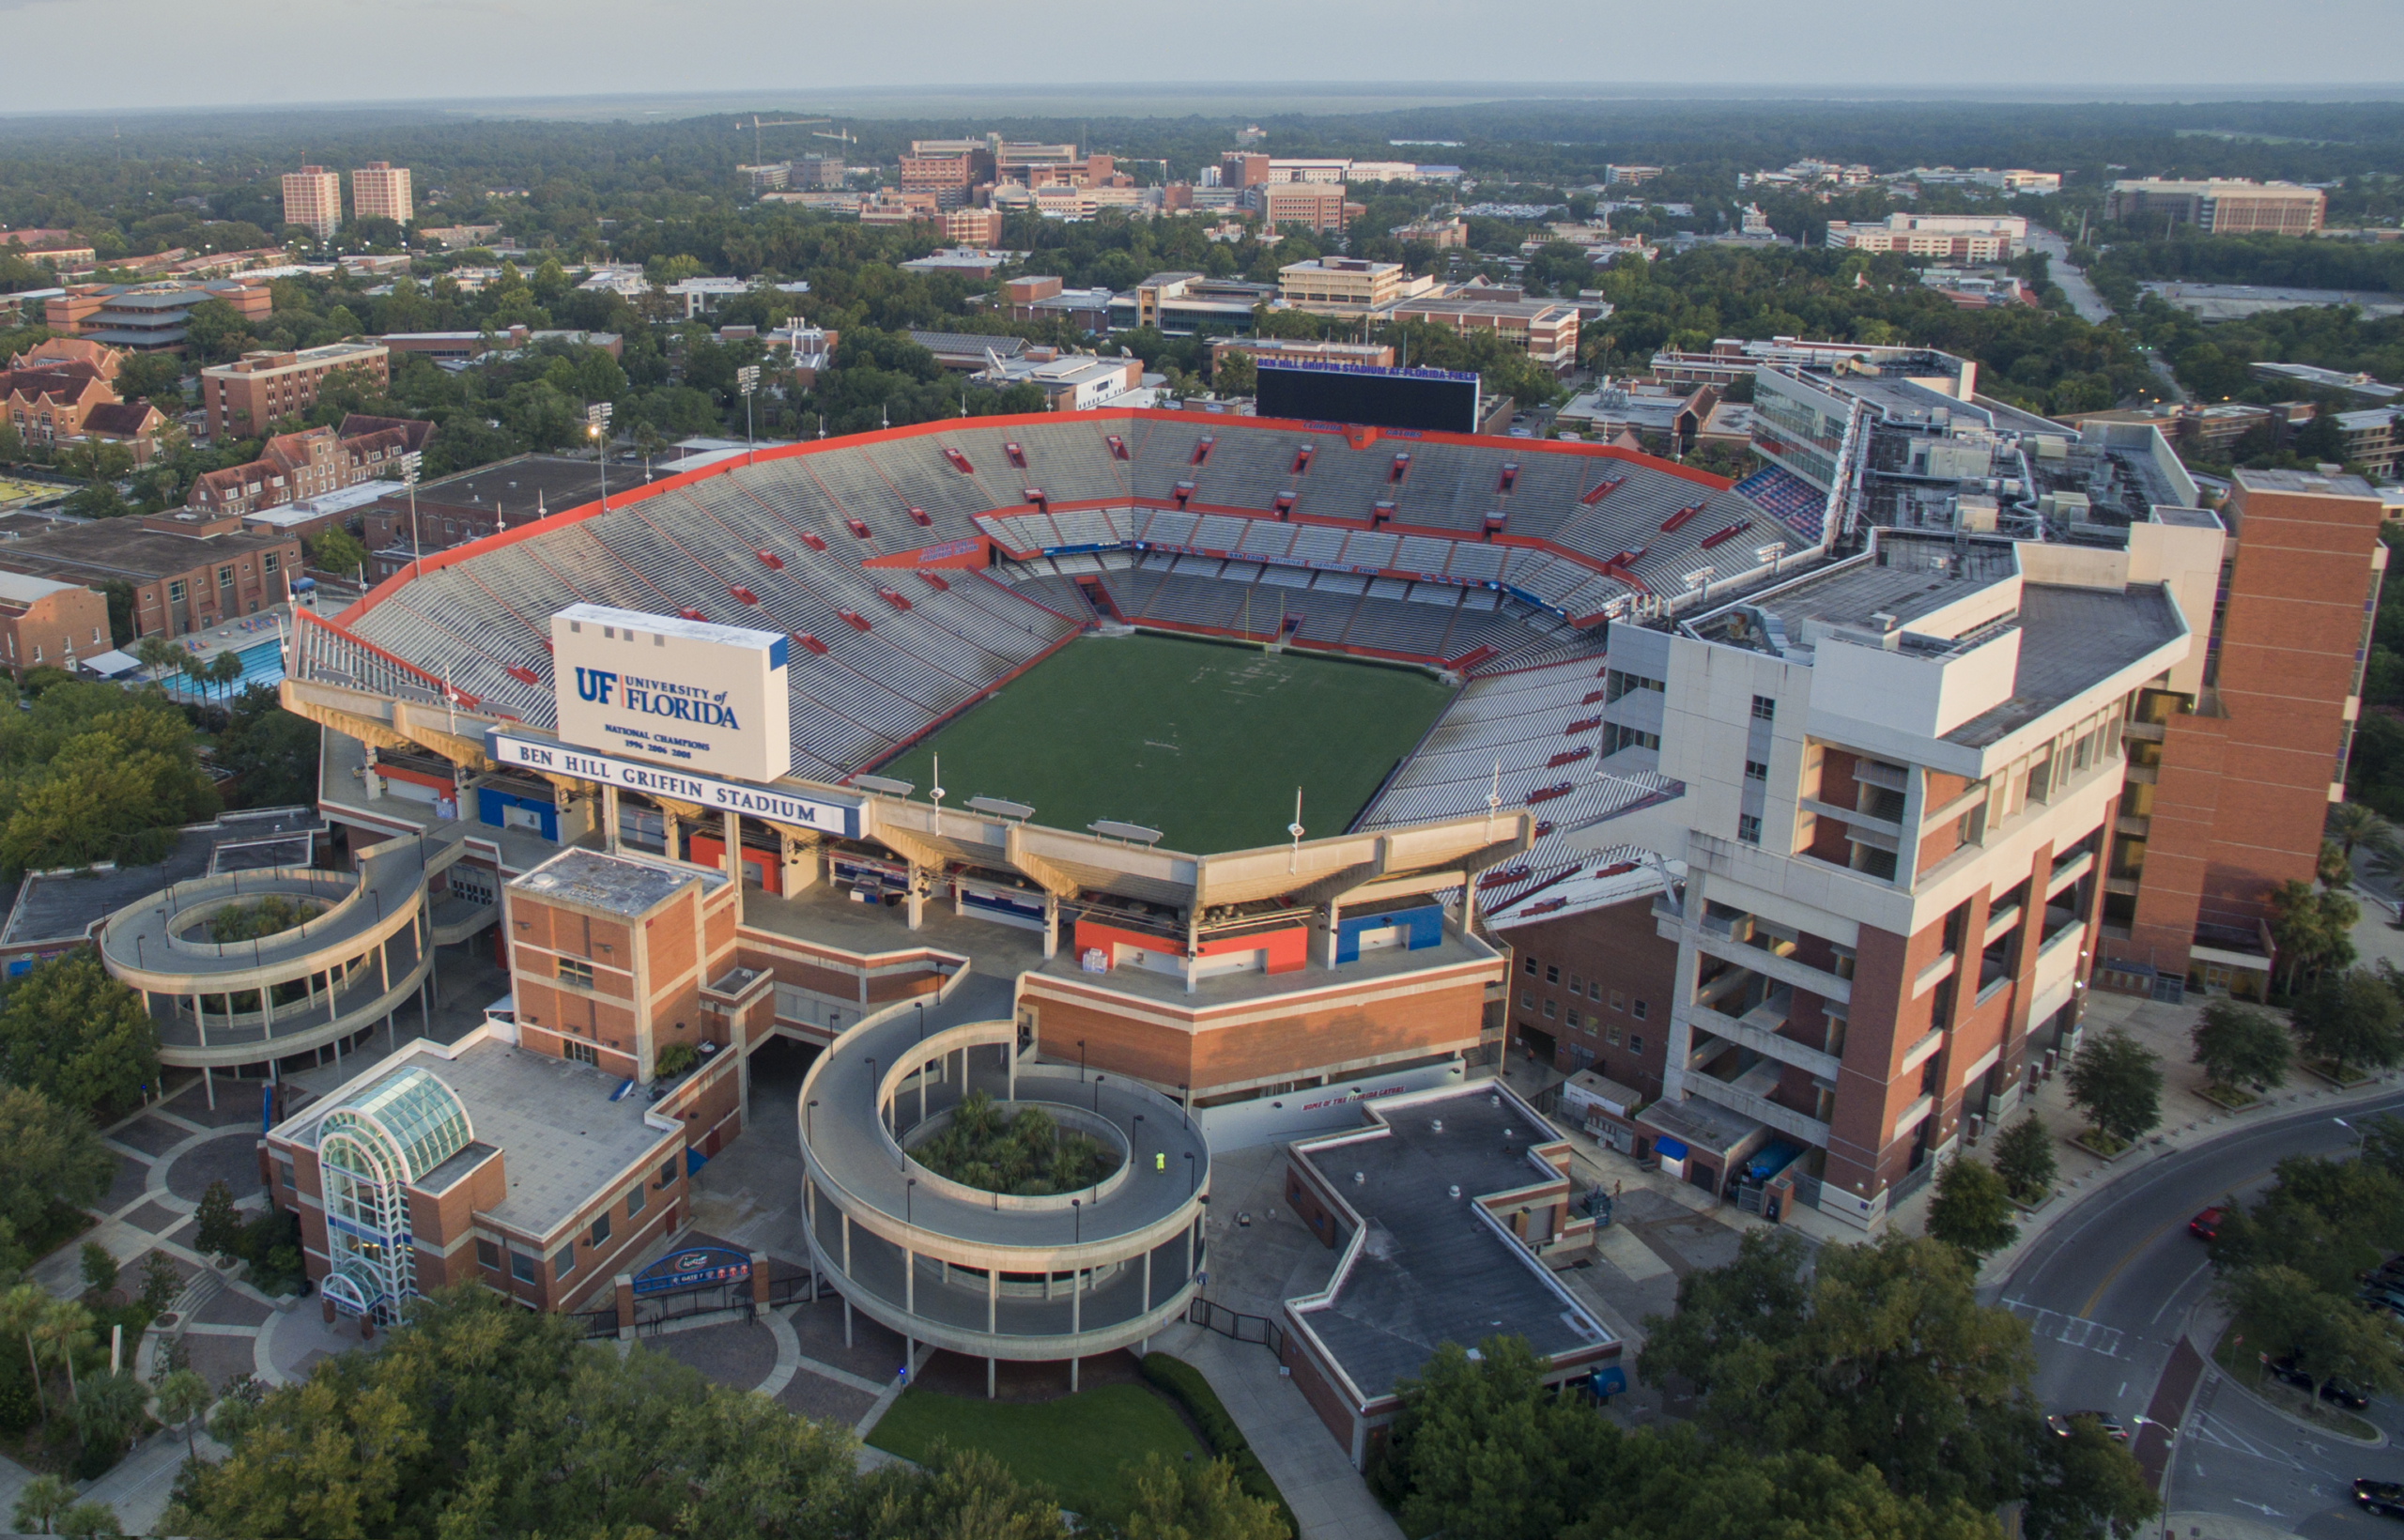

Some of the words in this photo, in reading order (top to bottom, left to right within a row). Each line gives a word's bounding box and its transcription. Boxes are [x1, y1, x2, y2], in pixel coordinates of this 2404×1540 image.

[1257, 358, 1275, 367] BEN
[1279, 360, 1299, 368] HILL
[1302, 361, 1340, 372] GRIFFIN
[1342, 363, 1386, 375] STADIUM
[1389, 367, 1400, 377] AT
[1403, 367, 1445, 379] FLORIDA
[1448, 371, 1477, 381] FIELD
[1302, 423, 1342, 431] FLORIDA
[1385, 429, 1423, 439] GATORS
[575, 667, 618, 704] UF
[624, 675, 709, 700] UNIVERSITY
[714, 691, 728, 705] of
[625, 687, 741, 731] FLORIDA
[605, 724, 651, 740] NATIONAL
[654, 733, 710, 751] CHAMPIONS
[624, 739, 644, 749] 1996
[648, 744, 668, 755] 2006
[671, 748, 692, 760] 2008
[519, 746, 552, 765] BEN
[565, 755, 610, 778] HILL
[622, 768, 702, 798] GRIFFIN
[717, 788, 816, 823] STADIUM
[1302, 1101, 1322, 1112] HOME
[1333, 1097, 1348, 1106] THE
[1348, 1091, 1378, 1102] FLORIDA
[682, 1273, 699, 1282] GATE
